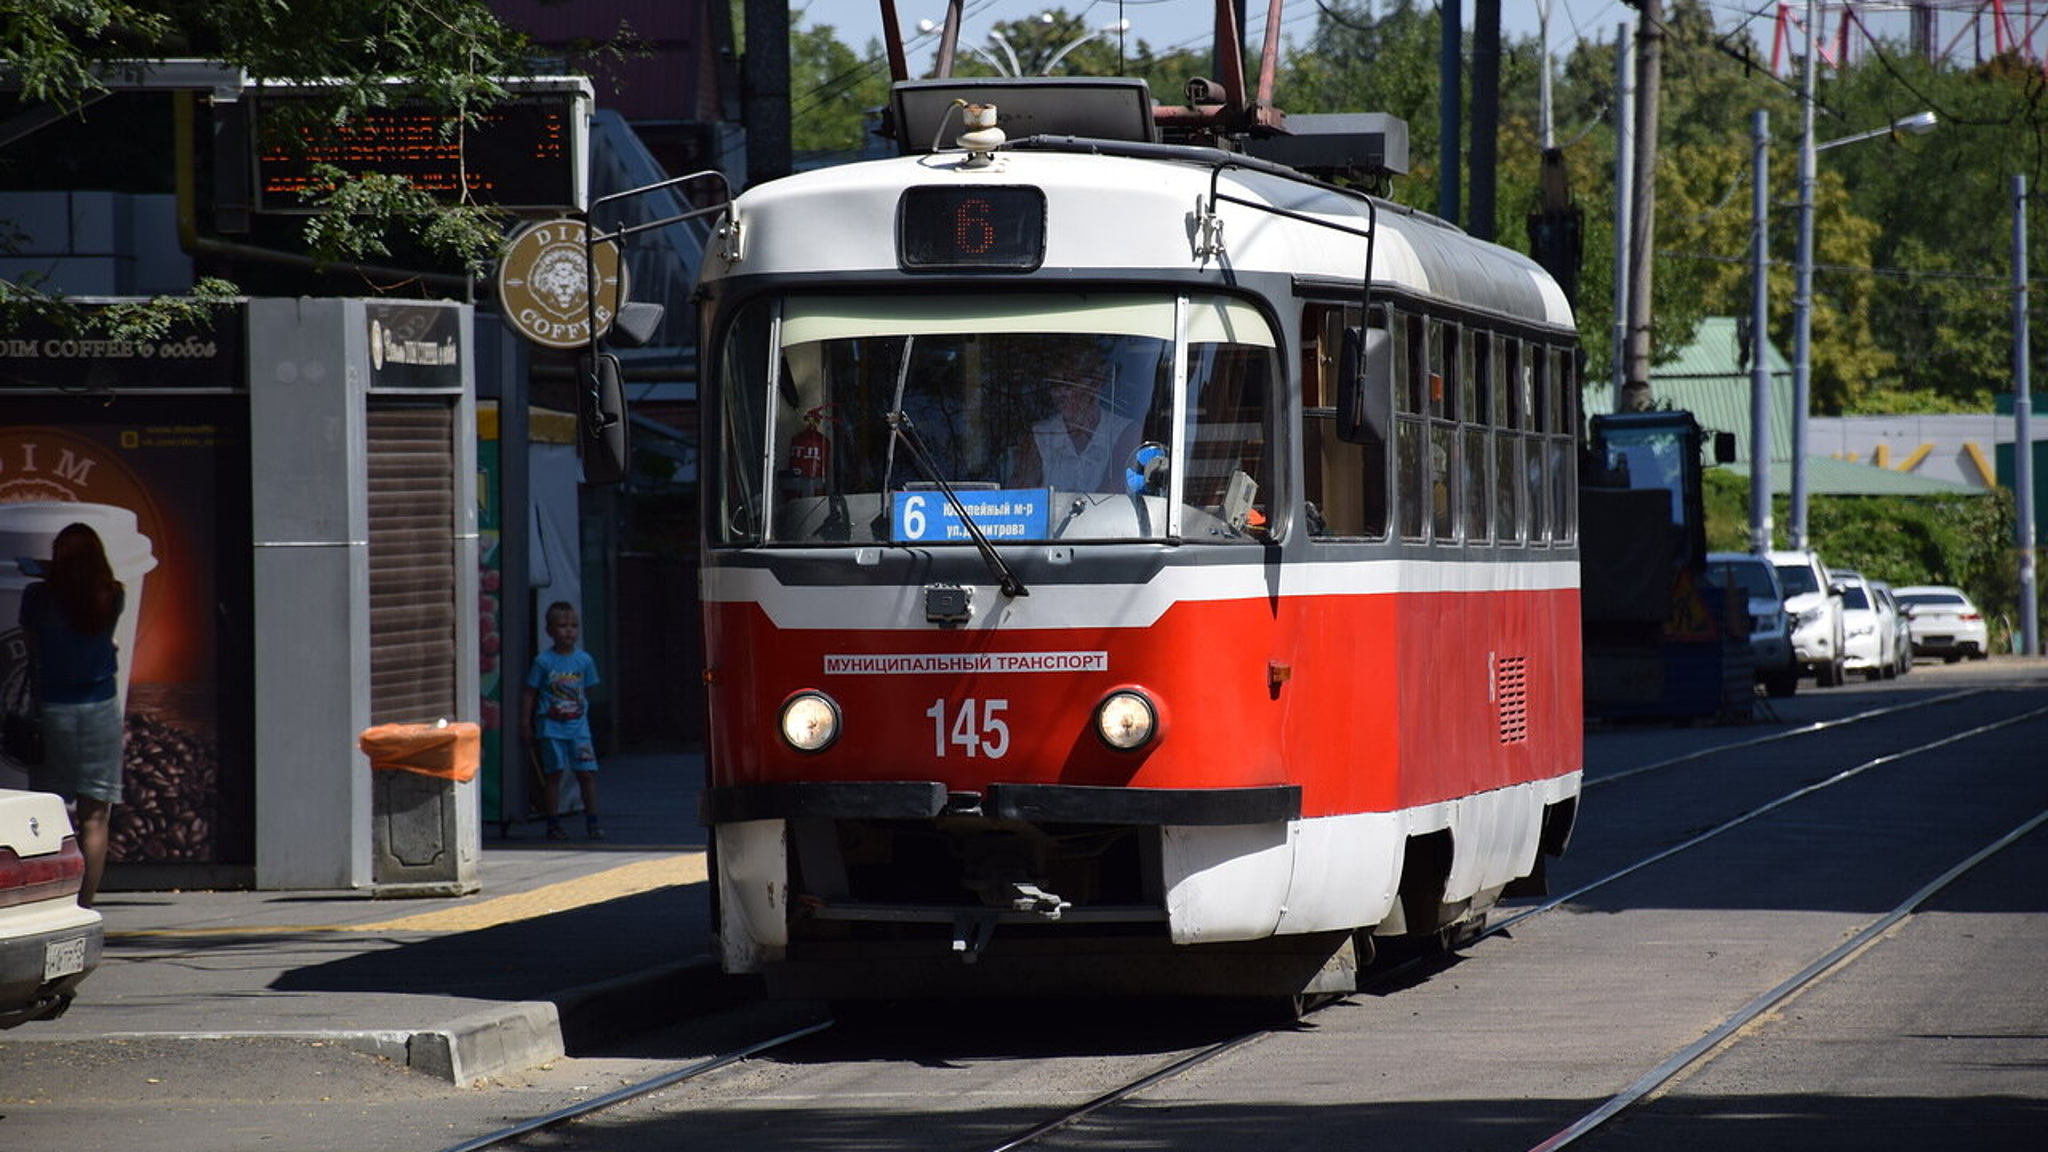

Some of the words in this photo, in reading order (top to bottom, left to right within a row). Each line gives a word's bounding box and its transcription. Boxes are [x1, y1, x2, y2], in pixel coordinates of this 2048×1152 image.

[956, 198, 993, 254] 6
[44, 340, 134, 358] COFFEE
[0, 443, 97, 487] IM
[903, 495, 927, 540] 6
[943, 502, 1011, 517] Юлейный
[826, 653, 992, 674] МУНИЦИПАЛЬНЫЙ
[997, 654, 1105, 671] ТРАНСПОРТ
[926, 698, 1010, 759] 145
